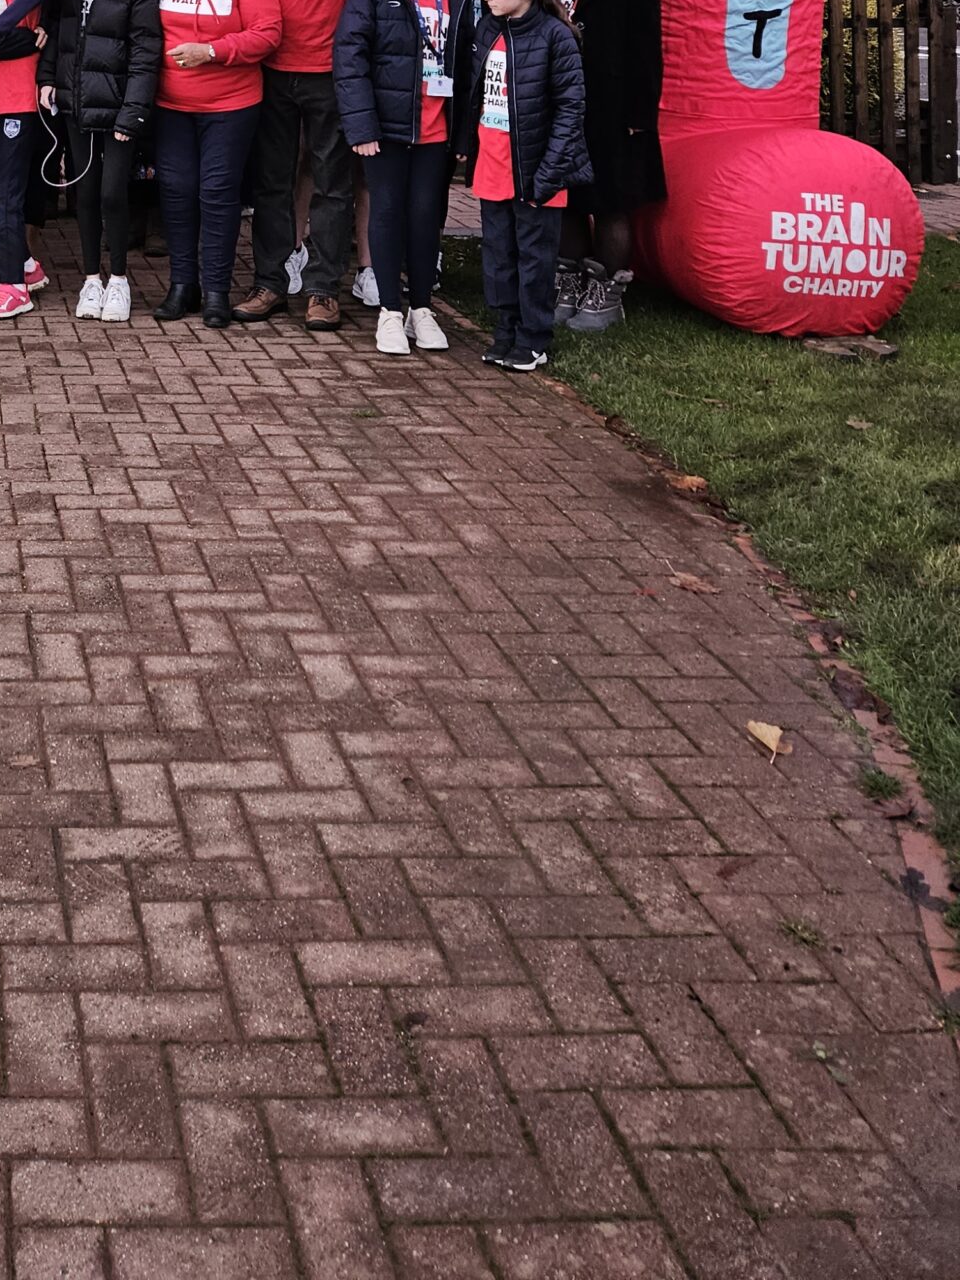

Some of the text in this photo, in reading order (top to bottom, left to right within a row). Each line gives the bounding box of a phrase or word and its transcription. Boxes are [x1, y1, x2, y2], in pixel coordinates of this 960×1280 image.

[490, 61, 504, 70] THE
[801, 192, 844, 213] THE
[771, 202, 891, 247] BRAIN
[761, 241, 907, 277] TUMOUR
[783, 276, 884, 298] CHARITY
